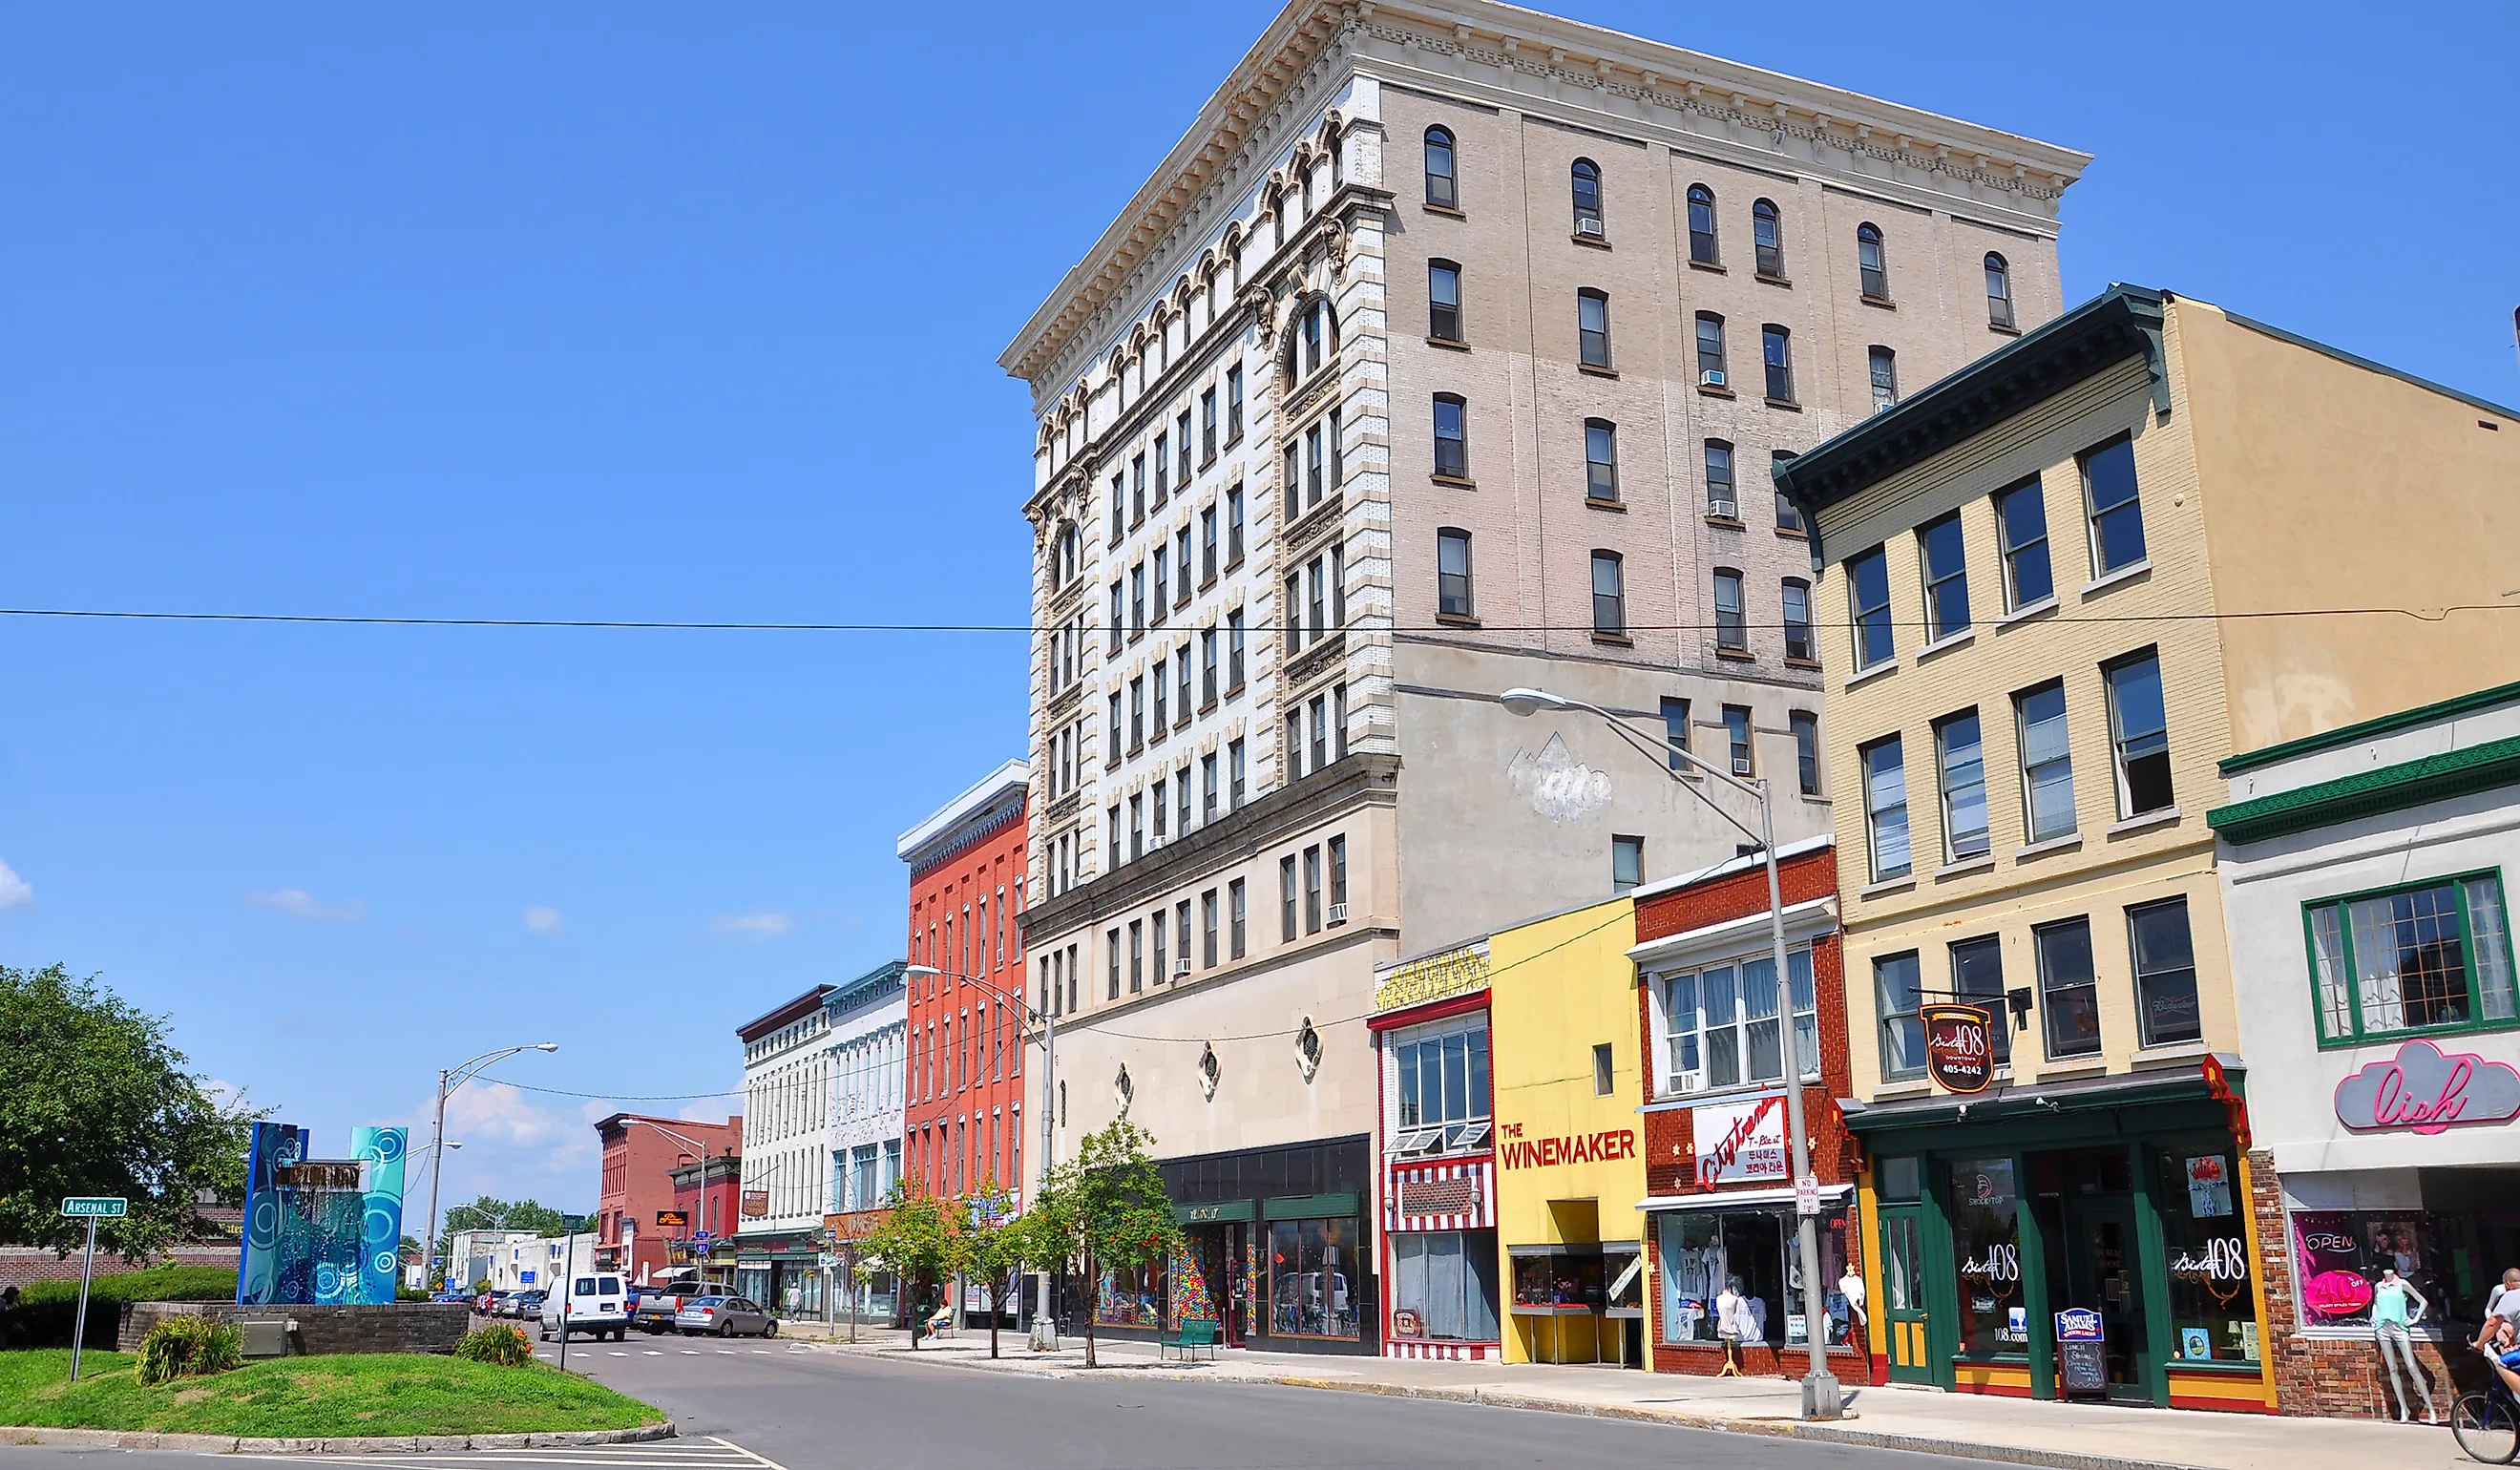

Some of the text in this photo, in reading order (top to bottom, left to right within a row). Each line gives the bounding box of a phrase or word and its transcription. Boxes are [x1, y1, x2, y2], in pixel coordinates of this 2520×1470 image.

[1955, 1024, 1984, 1056] 108
[1942, 1064, 1982, 1075] 405-4242
[2373, 1058, 2472, 1124] lish
[1501, 1123, 1523, 1139] THE
[1500, 1129, 1636, 1170] WINEMAKER
[66, 1200, 122, 1214] ARSENAL ST
[1990, 1196, 2004, 1205] TOP
[2307, 1235, 2353, 1250] OPEN
[1988, 1243, 2019, 1281] 108
[2207, 1237, 2245, 1280] 108
[2351, 1279, 2364, 1288] OFF
[2061, 1313, 2097, 1325] SAMUEL
[2064, 1319, 2096, 1333] ADAMS
[1994, 1327, 2028, 1343] 108.com
